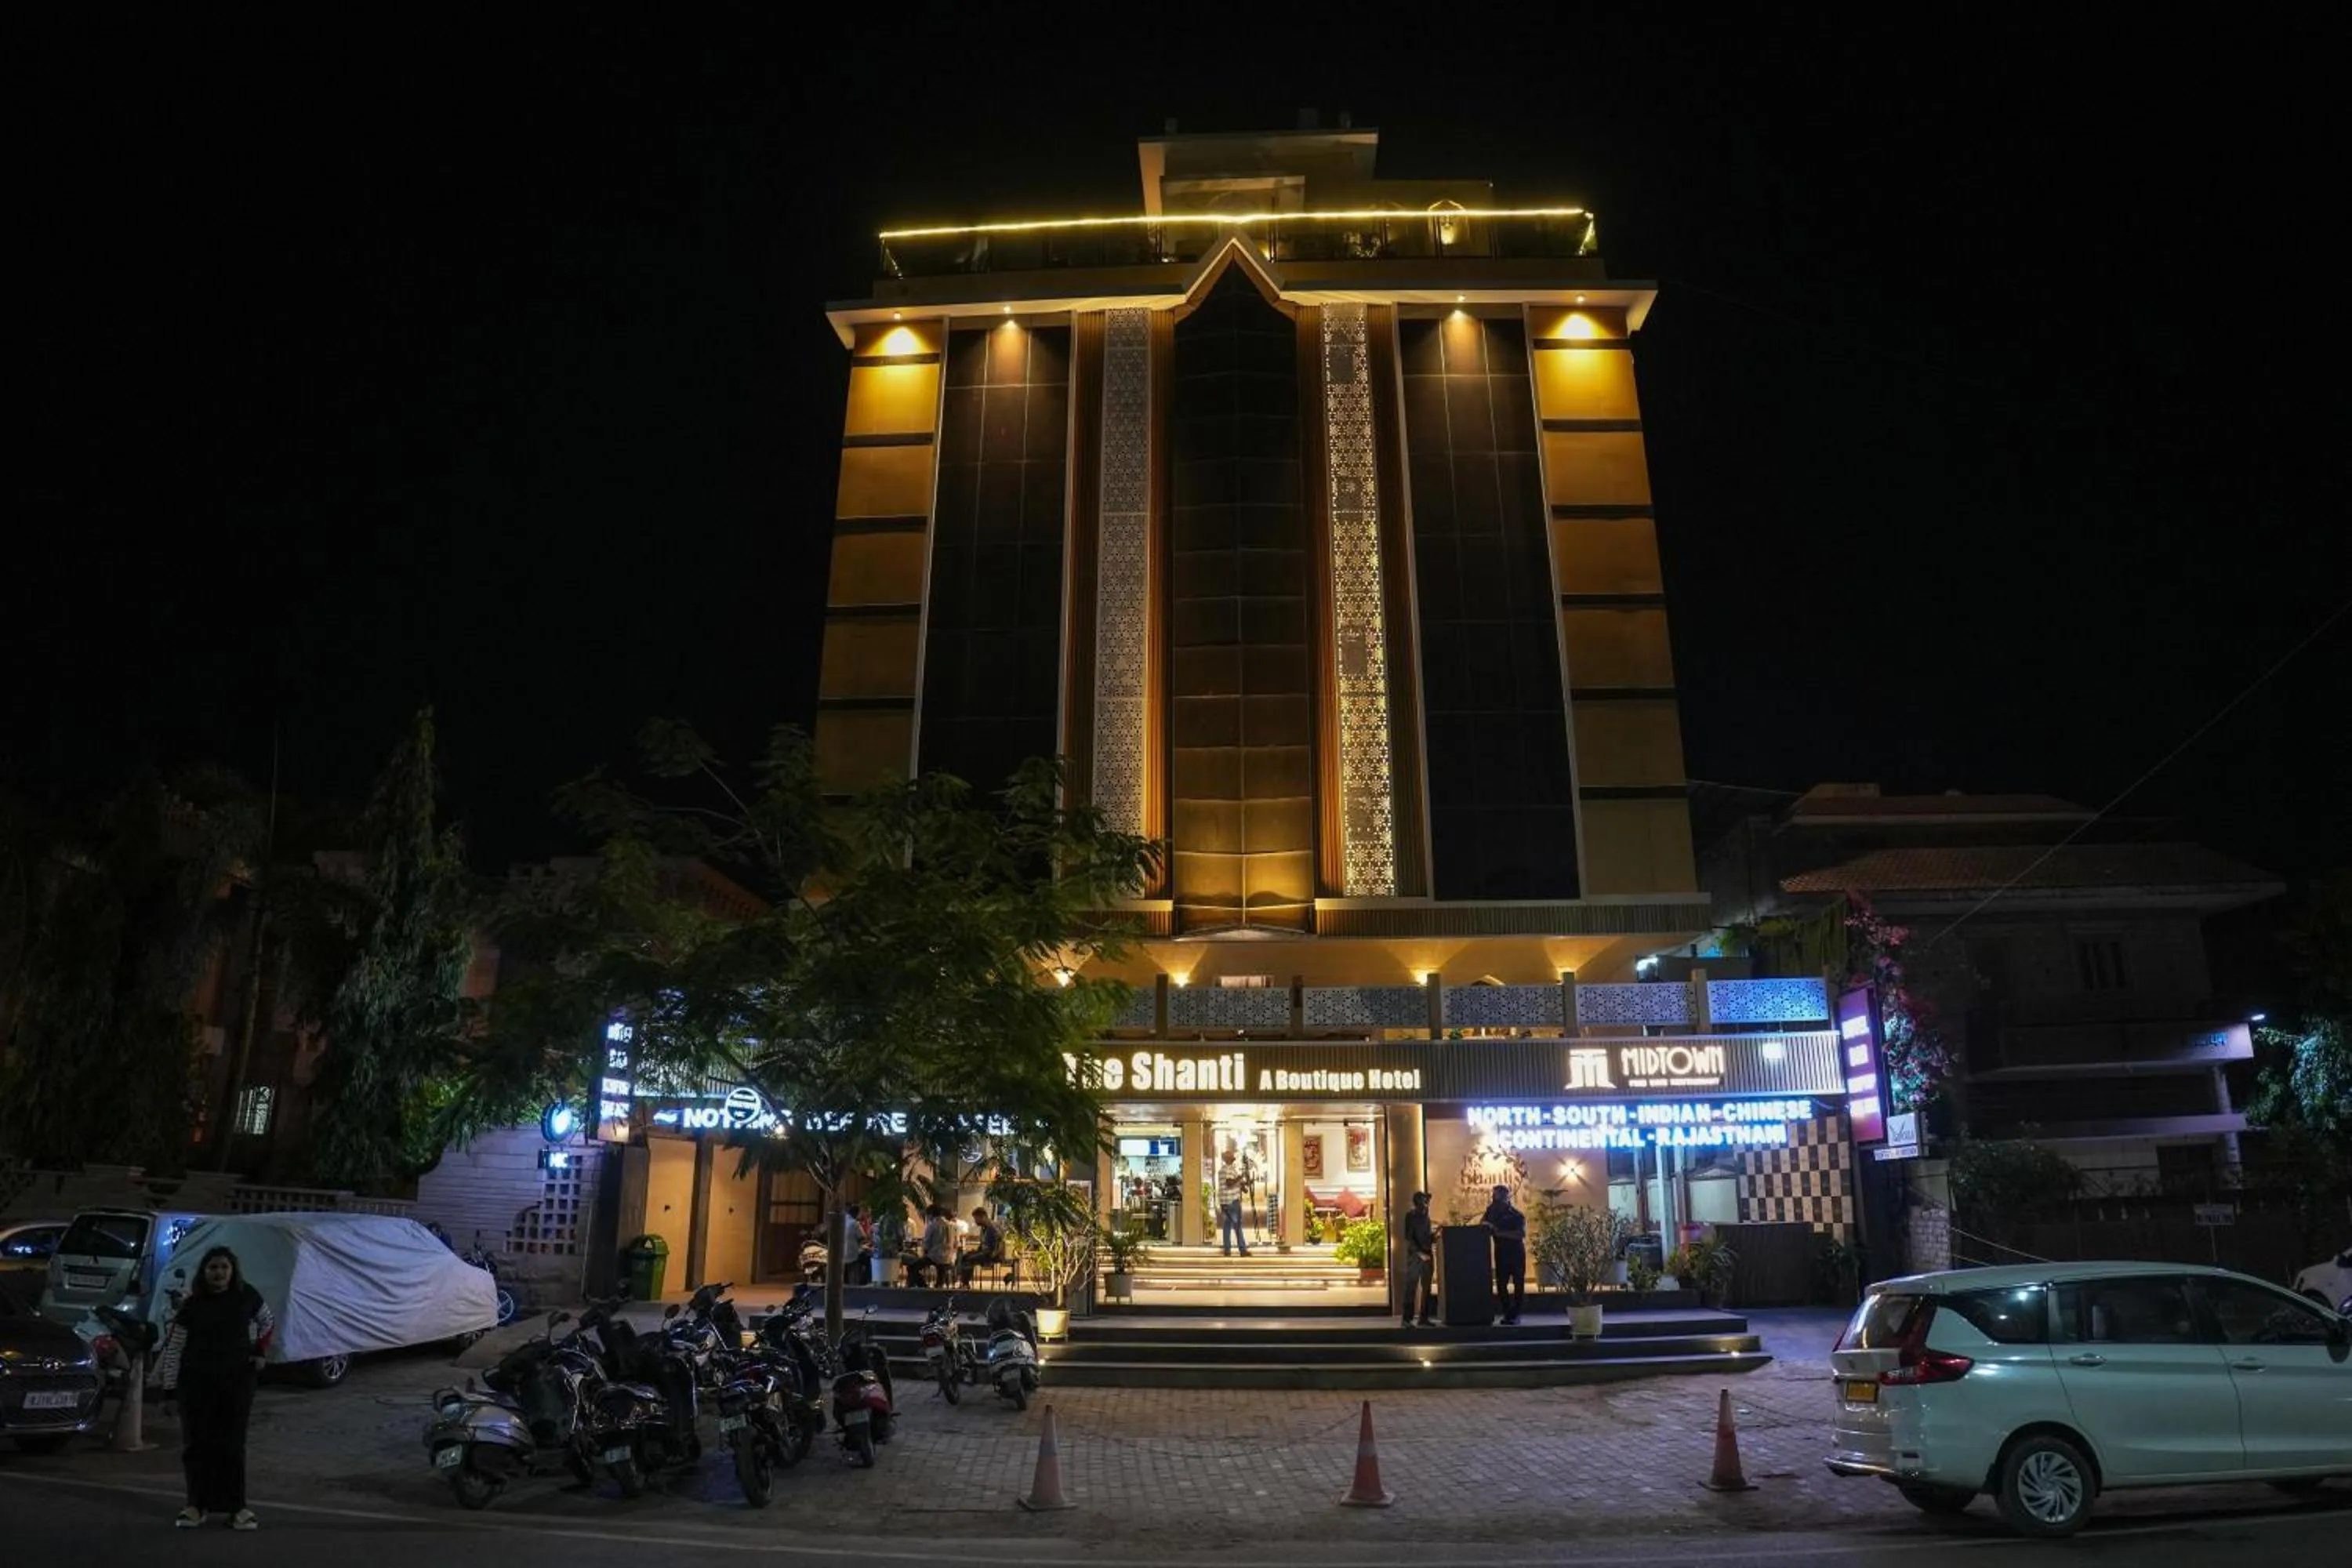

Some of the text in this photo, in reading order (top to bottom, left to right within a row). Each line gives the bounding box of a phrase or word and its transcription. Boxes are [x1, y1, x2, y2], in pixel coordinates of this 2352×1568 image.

[1131, 1051, 1245, 1091] Shanti
[1259, 1069, 1273, 1091] A
[1275, 1069, 1365, 1092] Boutique
[1367, 1068, 1421, 1090] Hotel
[1621, 1046, 1724, 1076] MIDTOWN
